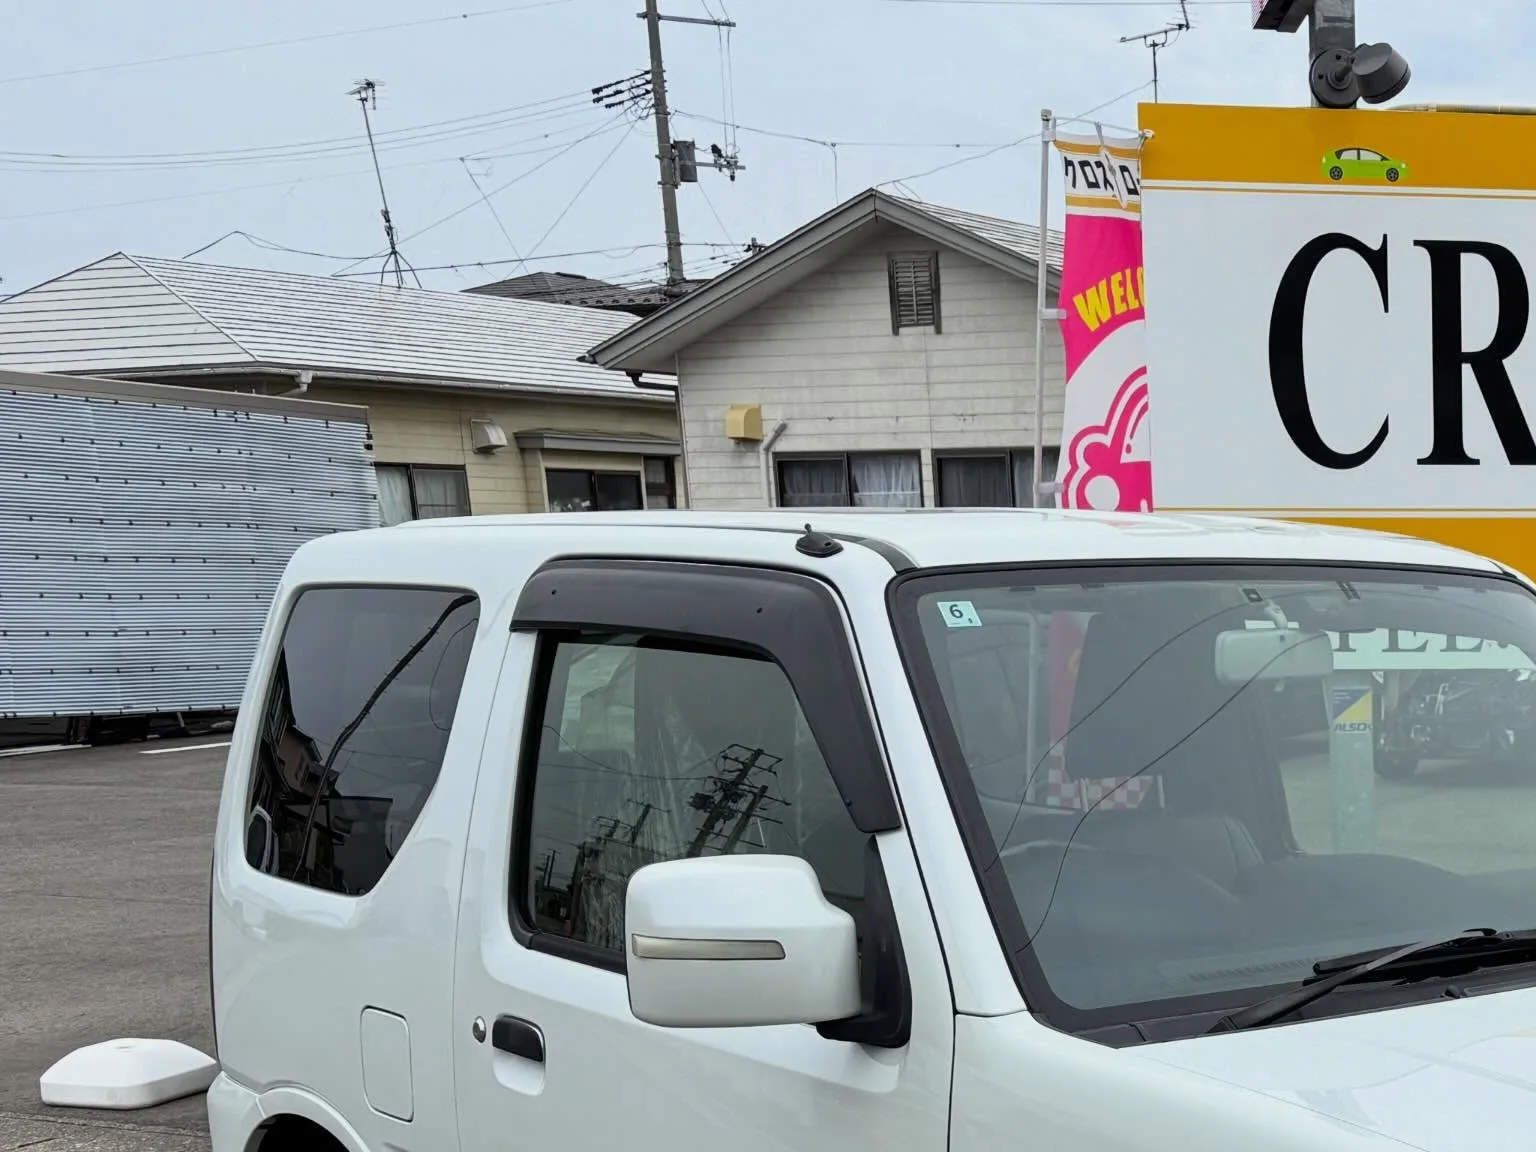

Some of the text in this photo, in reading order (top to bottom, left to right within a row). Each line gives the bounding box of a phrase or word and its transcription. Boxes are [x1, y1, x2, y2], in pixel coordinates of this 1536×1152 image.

[1063, 155, 1140, 196] クロスロ
[949, 603, 963, 619] 6
